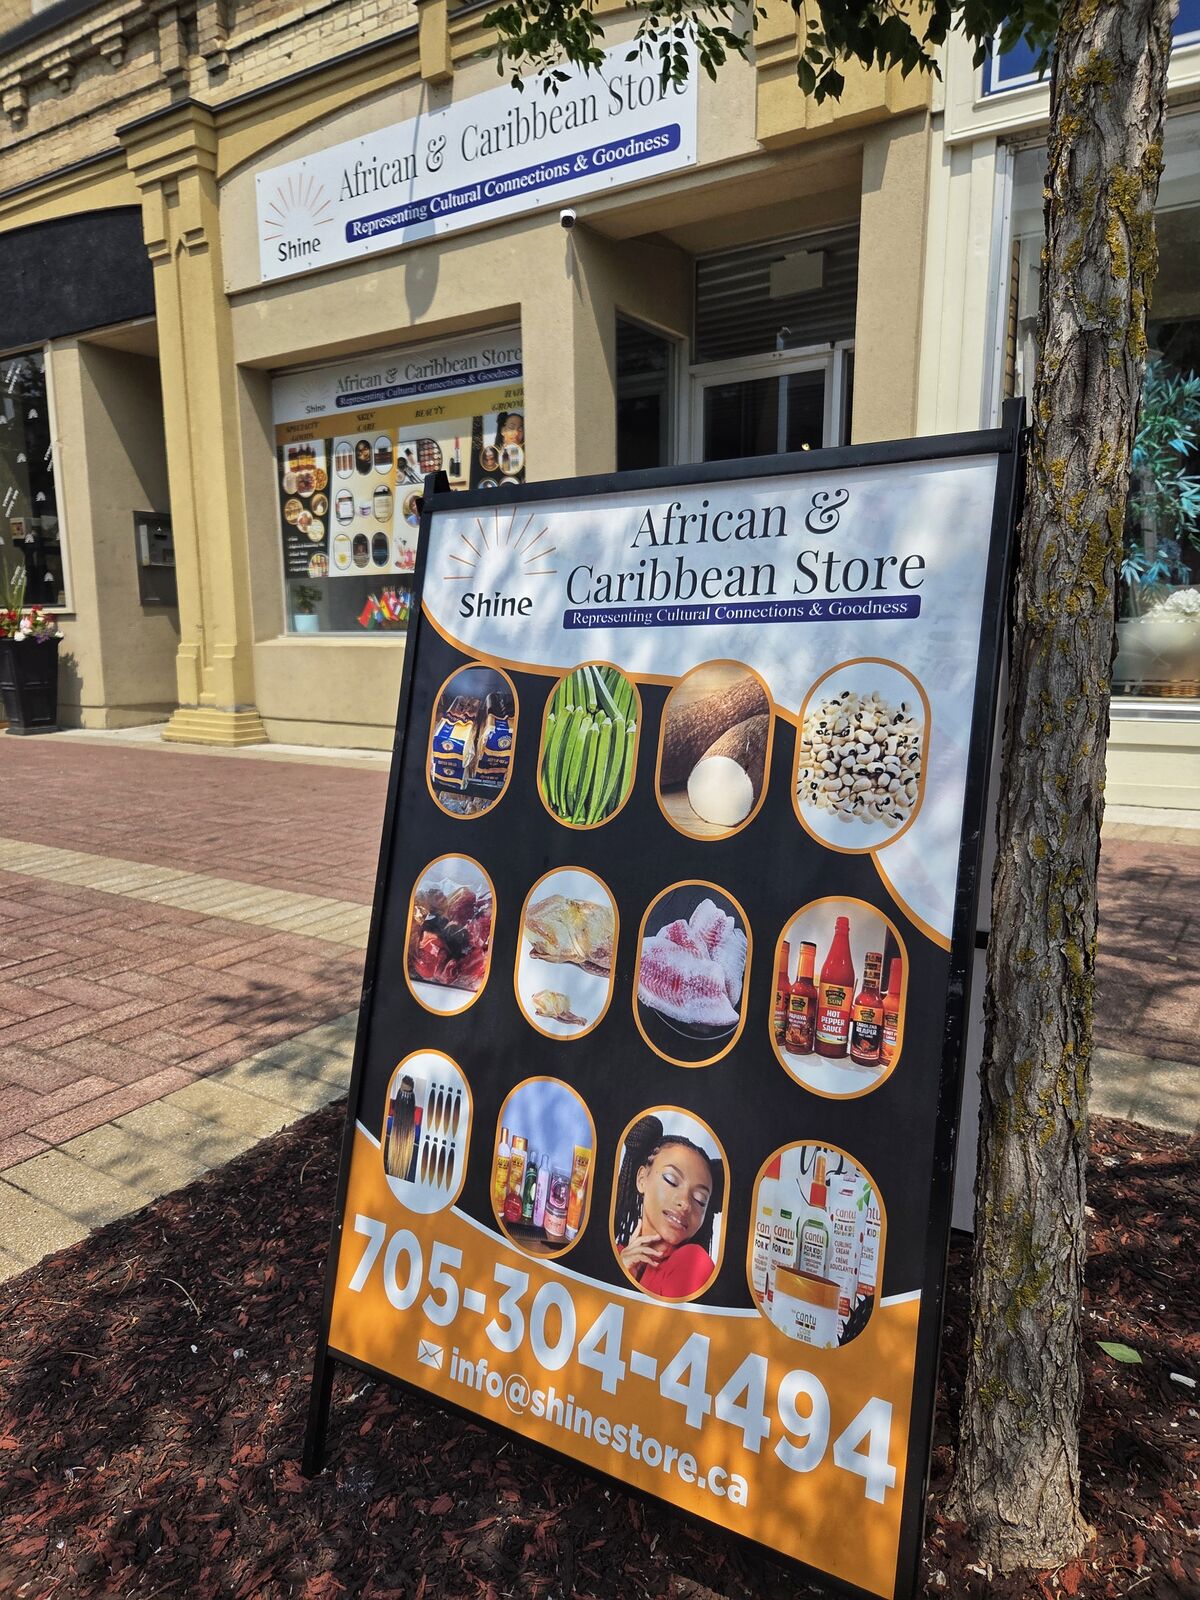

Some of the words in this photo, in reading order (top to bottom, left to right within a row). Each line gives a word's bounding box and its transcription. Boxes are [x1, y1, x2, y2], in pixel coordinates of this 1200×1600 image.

[338, 154, 419, 202] African
[425, 134, 447, 173] &
[460, 94, 599, 163] Caribbean
[352, 202, 428, 236] Representing
[429, 183, 481, 216] Cultural
[484, 161, 570, 198] Connections
[573, 154, 589, 172] &
[592, 131, 670, 165] Goodness
[277, 235, 321, 262] Shine
[336, 372, 383, 394] African
[385, 367, 399, 384] &
[405, 354, 479, 381] Caribbean
[482, 347, 522, 367] Store
[339, 391, 386, 407] Representing
[386, 384, 417, 398] Cultural
[417, 376, 467, 392] Connections
[477, 366, 521, 383] Goodness
[305, 403, 327, 414] Shine
[415, 404, 446, 418] BEAUTY
[630, 499, 788, 548] African
[804, 488, 850, 535] &
[566, 556, 777, 606] Caribbean
[793, 549, 926, 595] Store
[459, 592, 533, 618] Shine
[572, 609, 653, 627] Representing
[656, 606, 711, 624] Cultural
[714, 602, 804, 620] Connections
[808, 601, 823, 617] &
[828, 599, 908, 616] Goodness
[821, 1016, 845, 1027] PEPPER
[826, 1009, 841, 1019] HOT
[822, 1024, 842, 1034] SAUCE
[773, 1224, 795, 1240] cantu
[804, 1231, 824, 1245] cantu
[772, 1243, 782, 1254] FOR
[835, 1247, 850, 1255] CREAM
[796, 1311, 817, 1326] cantu
[349, 1213, 897, 1505] 705-304-4494
[449, 1346, 750, 1508] info@shinestore.ca
